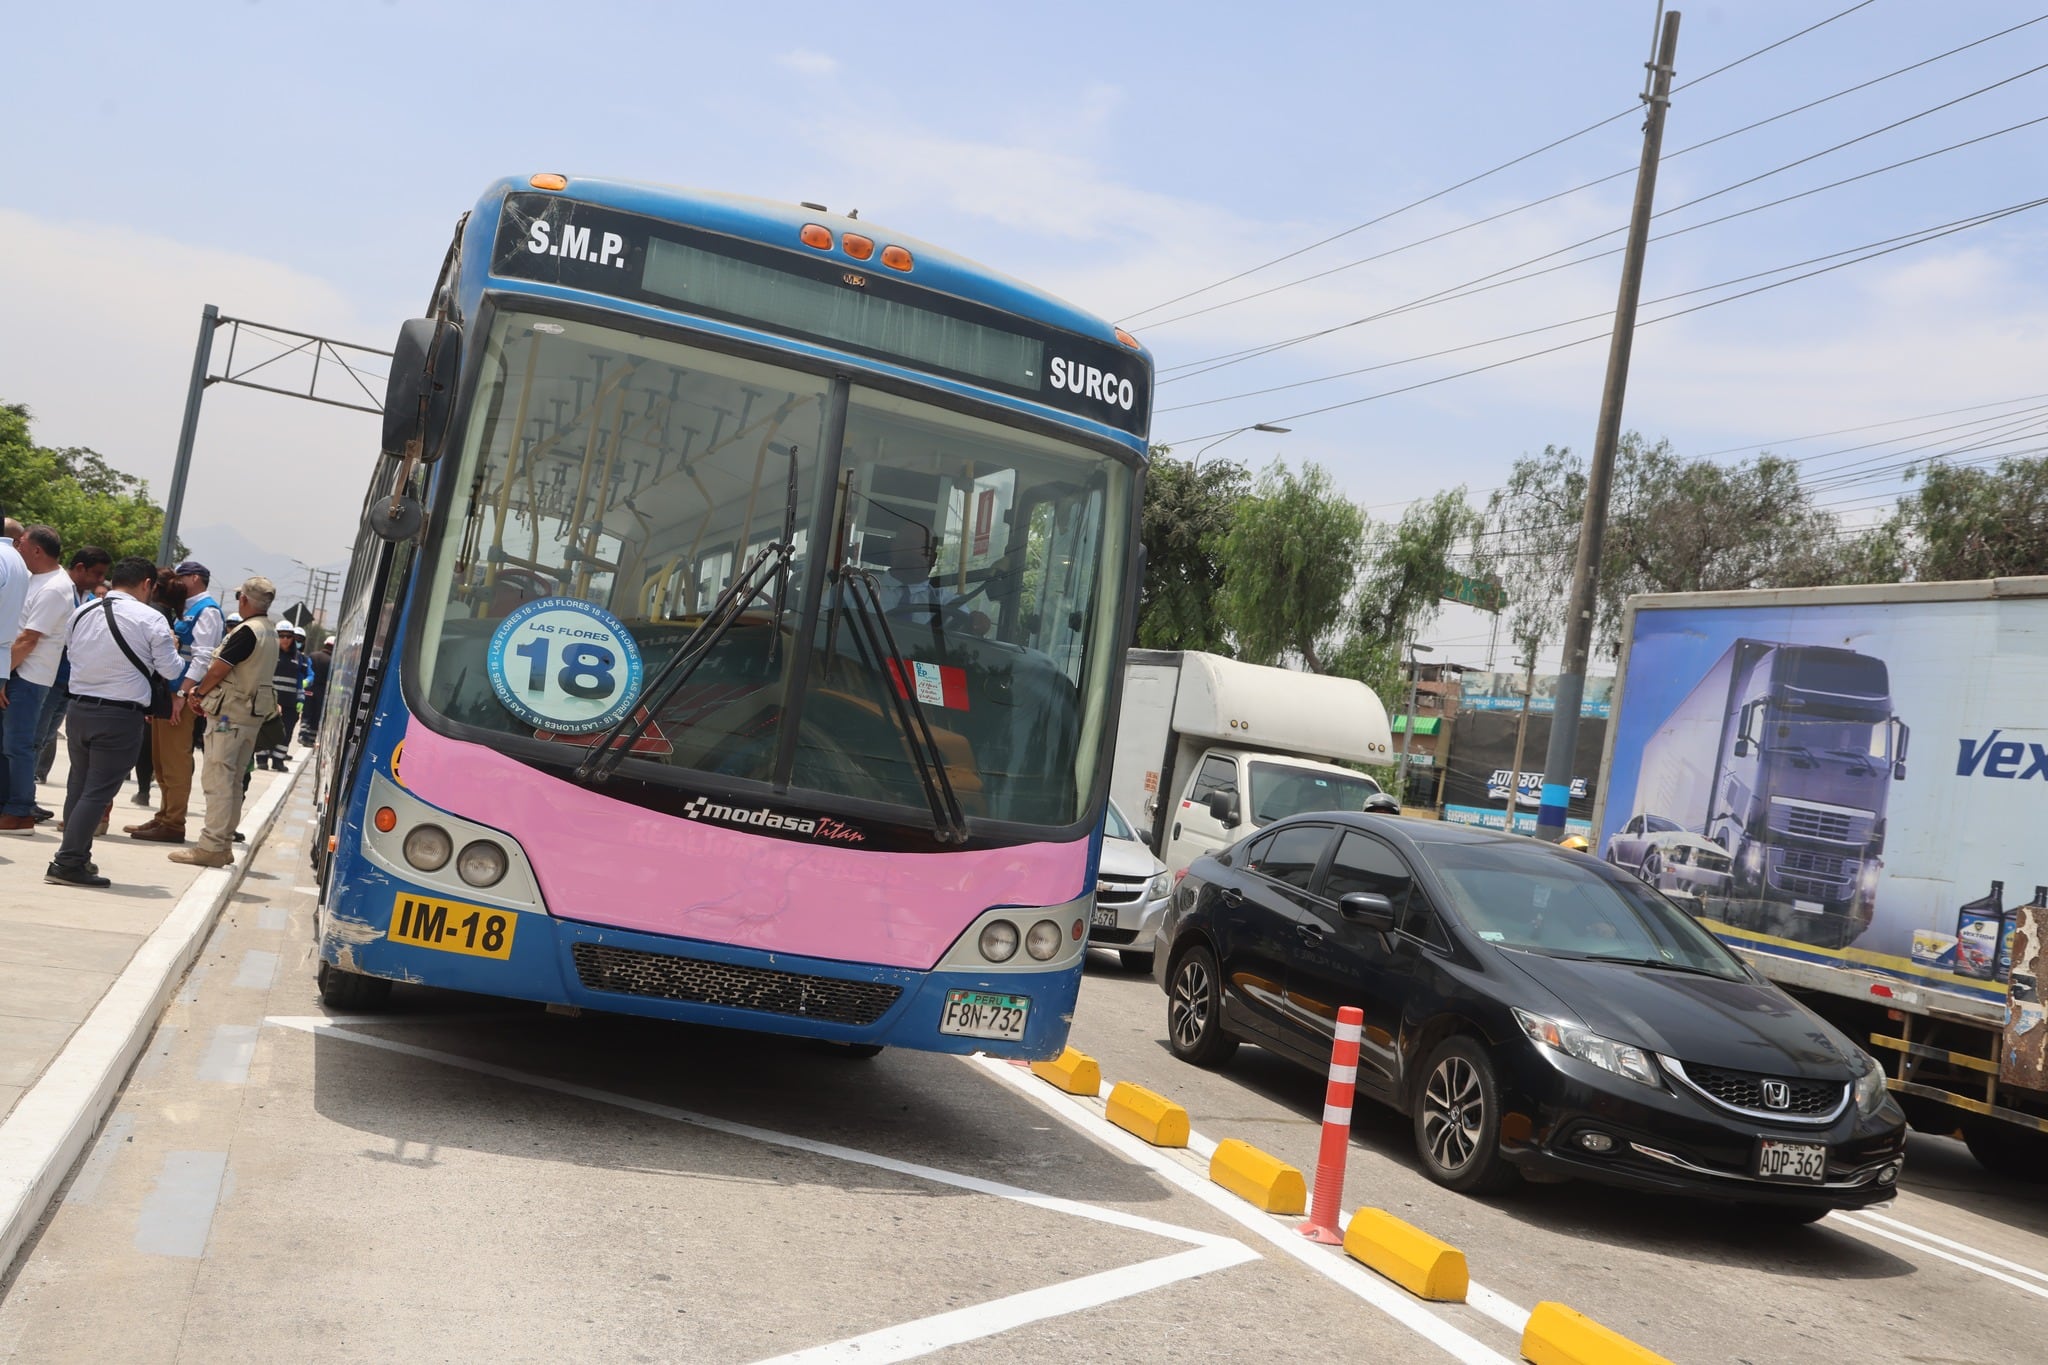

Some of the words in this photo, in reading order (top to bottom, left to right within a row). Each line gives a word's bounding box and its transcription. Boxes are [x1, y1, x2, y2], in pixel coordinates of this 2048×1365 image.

[527, 220, 625, 268] S.M.P.
[1050, 356, 1134, 411] SURCO
[537, 599, 554, 609] LAS
[556, 599, 590, 611] FLORES
[591, 607, 601, 617] 18
[493, 638, 503, 655] LAS
[499, 614, 522, 640] FLORES
[522, 606, 532, 616] 18
[529, 622, 555, 633] LAS
[558, 627, 610, 642] FLORES
[605, 616, 621, 632] LAS
[618, 629, 638, 660] FLORES
[631, 661, 640, 671] 18
[492, 661, 499, 671] 18
[516, 637, 616, 700] 18
[494, 673, 513, 704] FLORES
[631, 675, 640, 692] LAS
[510, 701, 526, 716] LAS
[612, 691, 635, 718] FLORES
[532, 716, 542, 725] 18
[545, 721, 580, 732] FLORES
[582, 722, 599, 732] LAS
[603, 715, 613, 724] 18
[702, 803, 816, 834] modasa
[813, 817, 866, 842] Titan
[398, 900, 506, 951] IM-18
[974, 995, 1003, 1005] PERU
[946, 1002, 1023, 1033] F8N-732
[1782, 1143, 1806, 1152] PERU
[1760, 1149, 1824, 1177] ADP-362
